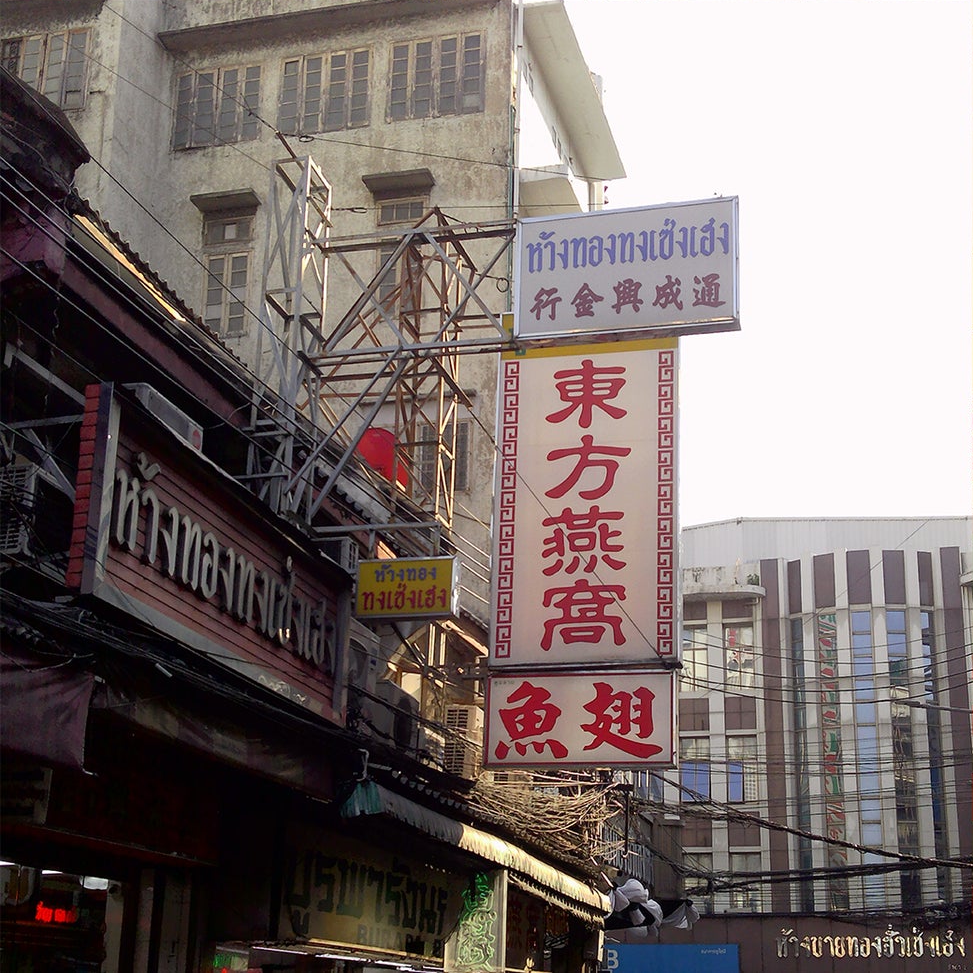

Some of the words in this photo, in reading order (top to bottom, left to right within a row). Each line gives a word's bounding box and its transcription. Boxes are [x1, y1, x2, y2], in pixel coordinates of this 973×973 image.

[540, 359, 632, 652] 東方燕窩
[374, 564, 437, 583] ห้างทอง
[494, 681, 664, 760] 魚翅
